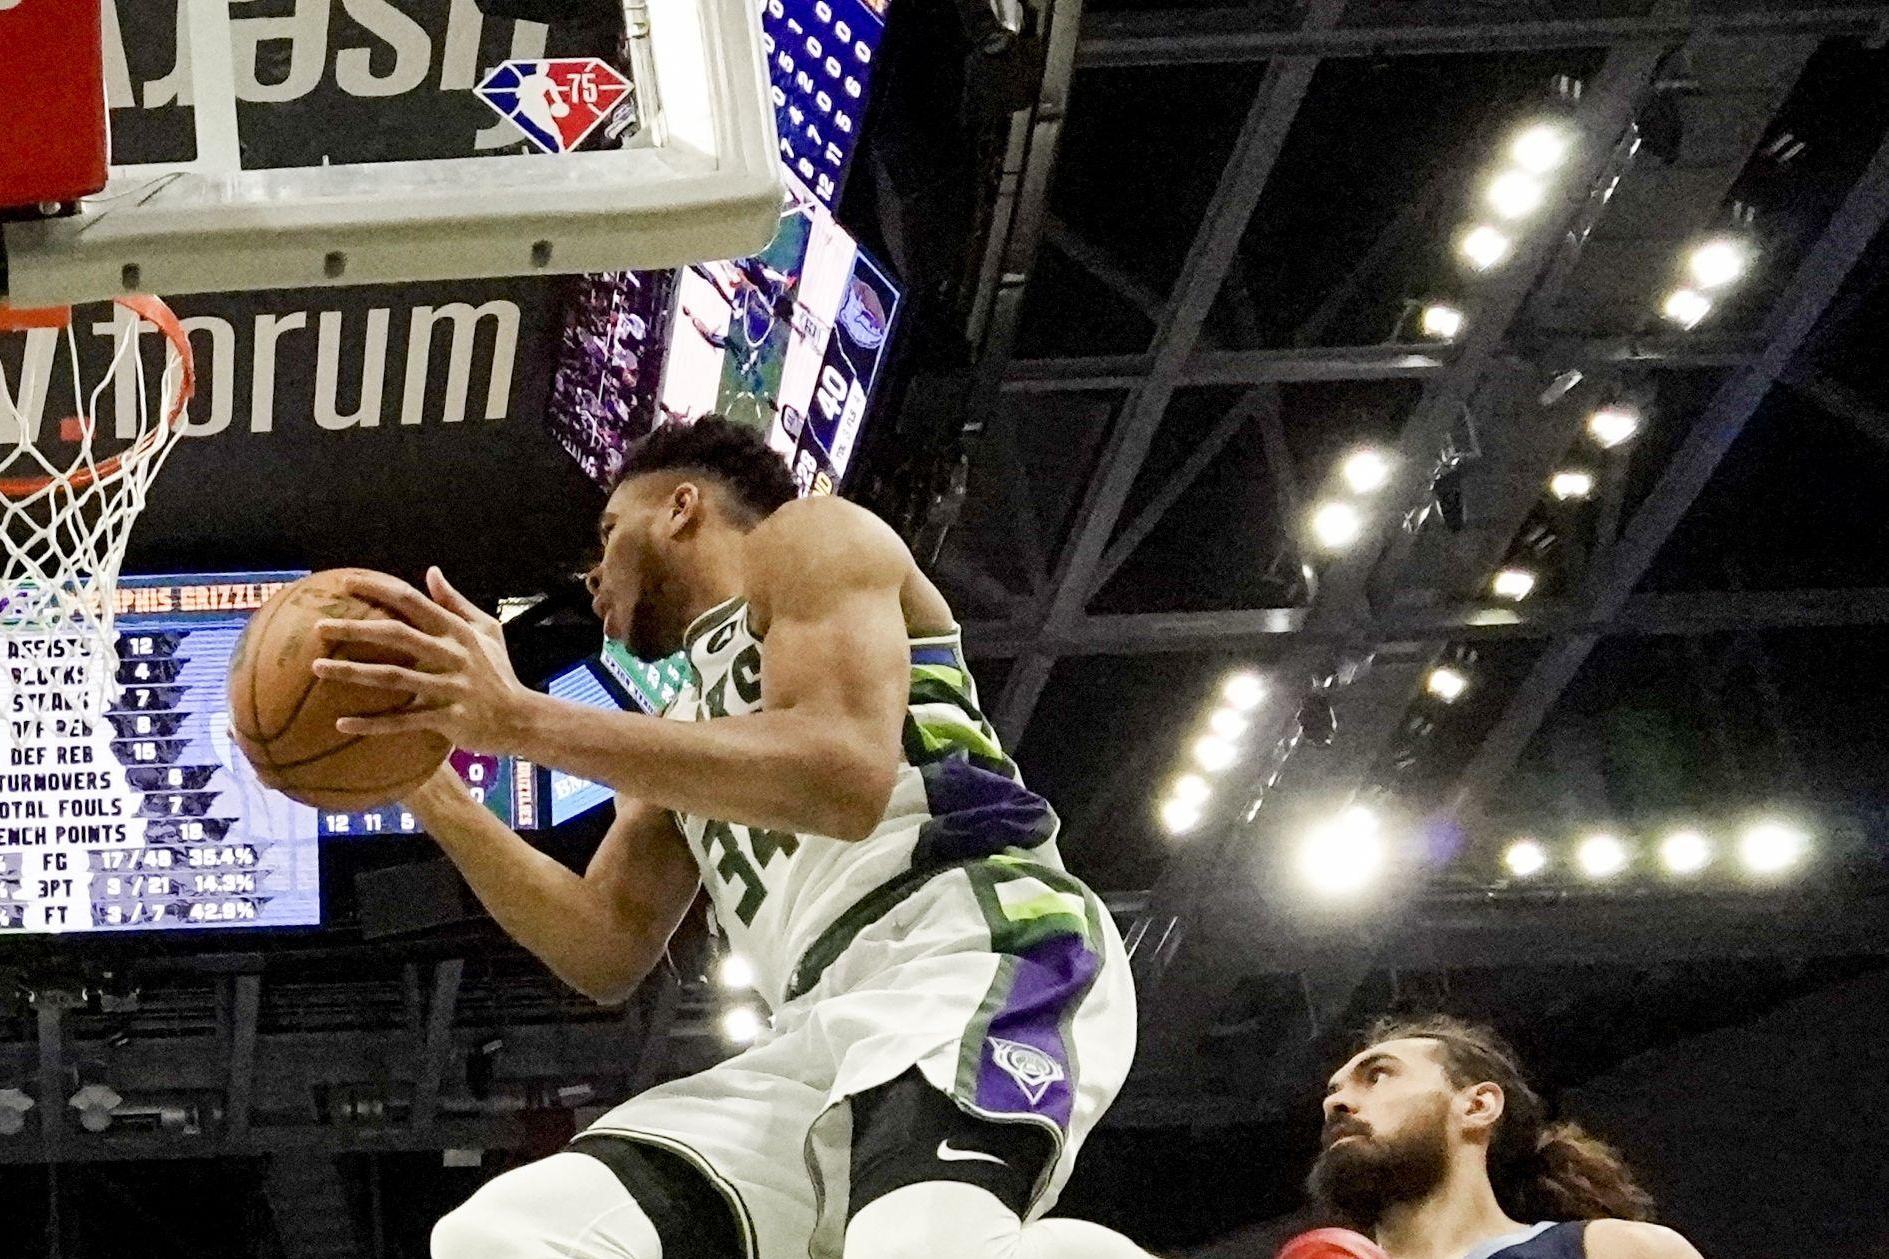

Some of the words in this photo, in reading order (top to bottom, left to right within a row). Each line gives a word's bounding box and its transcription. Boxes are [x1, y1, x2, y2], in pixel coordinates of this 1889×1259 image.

[788, 18, 803, 35] 1
[855, 41, 871, 63] 0
[566, 73, 597, 104] 75
[807, 124, 822, 145] 7
[816, 91, 832, 112] 0
[825, 56, 841, 78] 0
[835, 20, 851, 43] 0
[781, 137, 794, 158] 7
[789, 106, 804, 125] 4
[797, 71, 813, 94] 2
[806, 36, 822, 58] 0
[835, 110, 851, 132] 5
[825, 142, 843, 166] 11
[816, 173, 835, 201] 12
[817, 365, 848, 420] 40
[130, 638, 153, 655] 12
[135, 663, 150, 680] 4
[136, 690, 150, 707] 7
[137, 717, 151, 733] 8
[11, 746, 47, 766] DEF
[57, 745, 93, 764] REB
[133, 742, 157, 761] 15
[469, 763, 484, 781] 0
[59, 798, 122, 819] FOULS
[168, 797, 183, 813] 7
[326, 814, 349, 832] 12
[364, 813, 382, 831] 11
[400, 812, 415, 829] 5
[56, 824, 126, 845] POINTS
[43, 853, 68, 871] FG
[102, 852, 124, 868] 17
[38, 879, 73, 898] 3PT
[148, 877, 171, 894] 21
[45, 906, 69, 925] FT
[153, 905, 166, 922] 7
